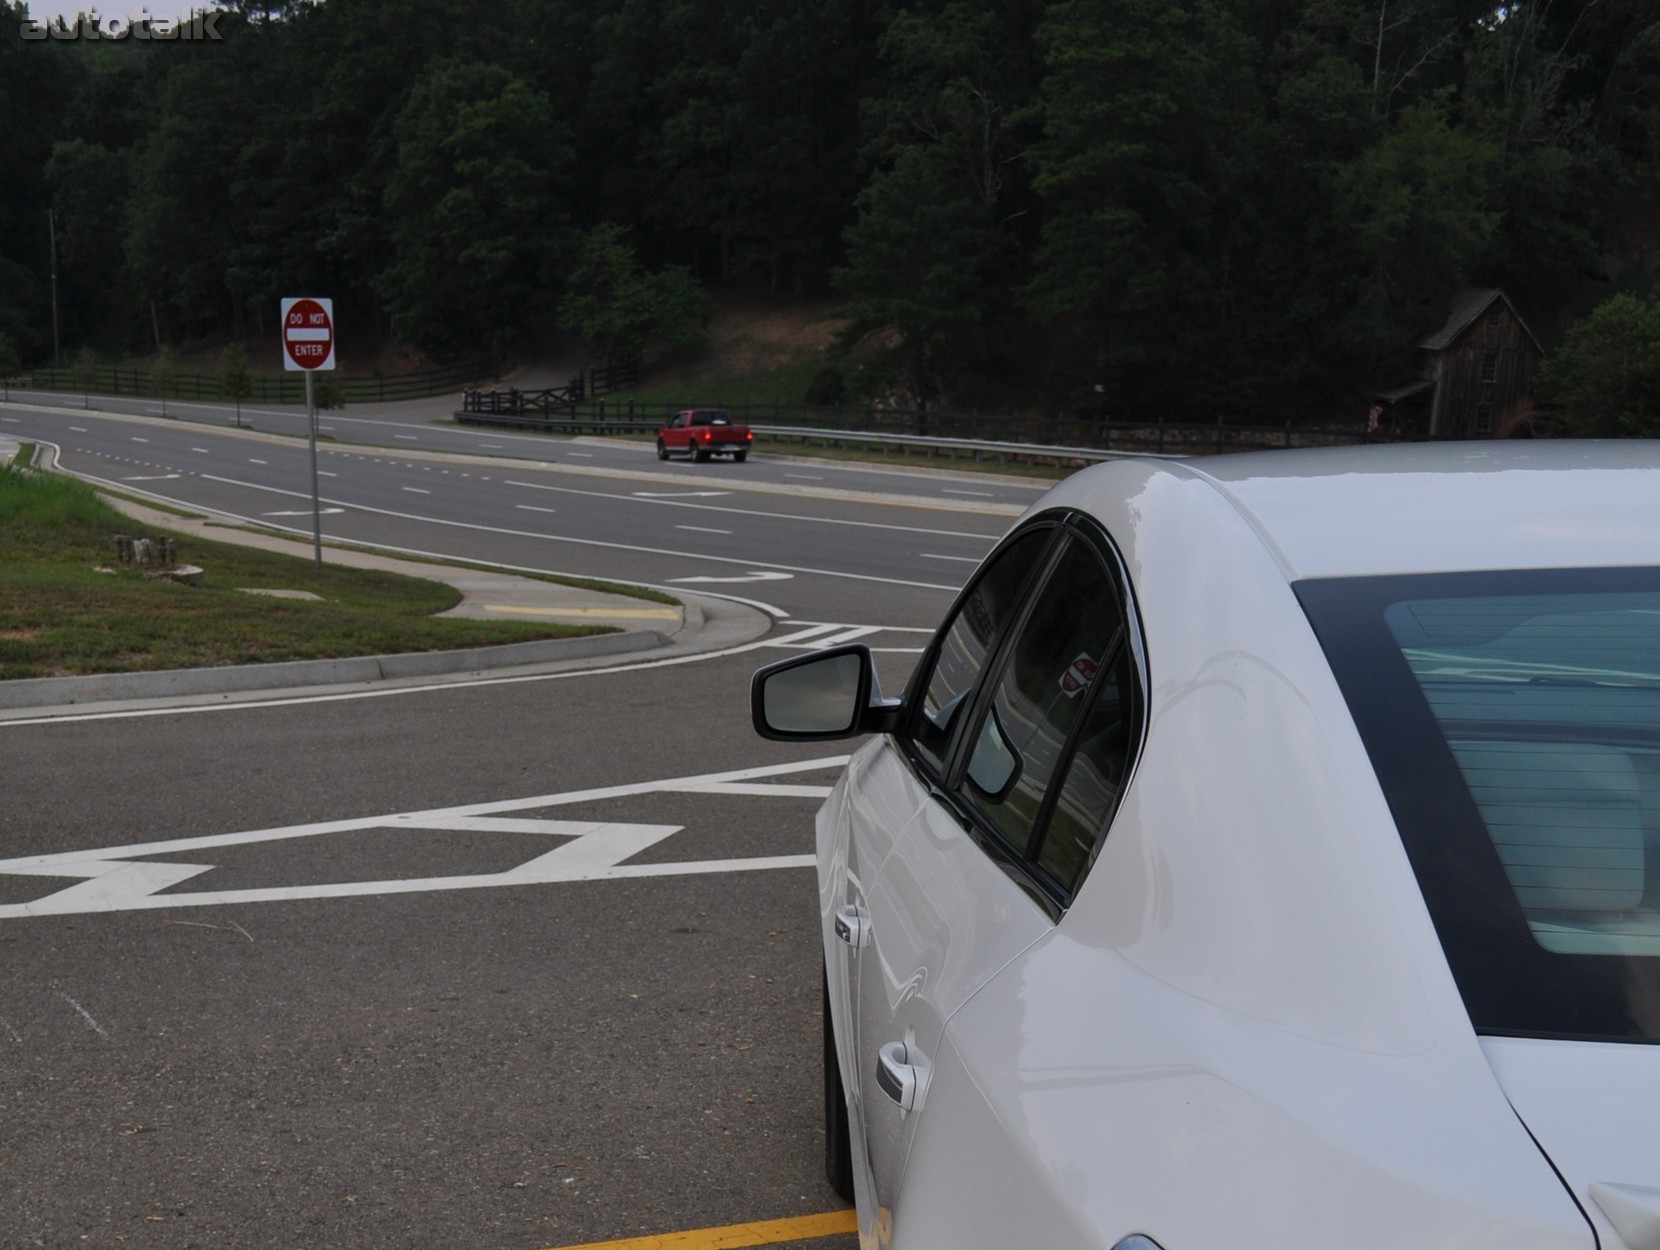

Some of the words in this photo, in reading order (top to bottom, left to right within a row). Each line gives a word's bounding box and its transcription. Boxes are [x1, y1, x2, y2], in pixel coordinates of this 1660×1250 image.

[290, 313, 303, 325] DO
[309, 313, 325, 325] NOT
[295, 344, 323, 356] ENTER
